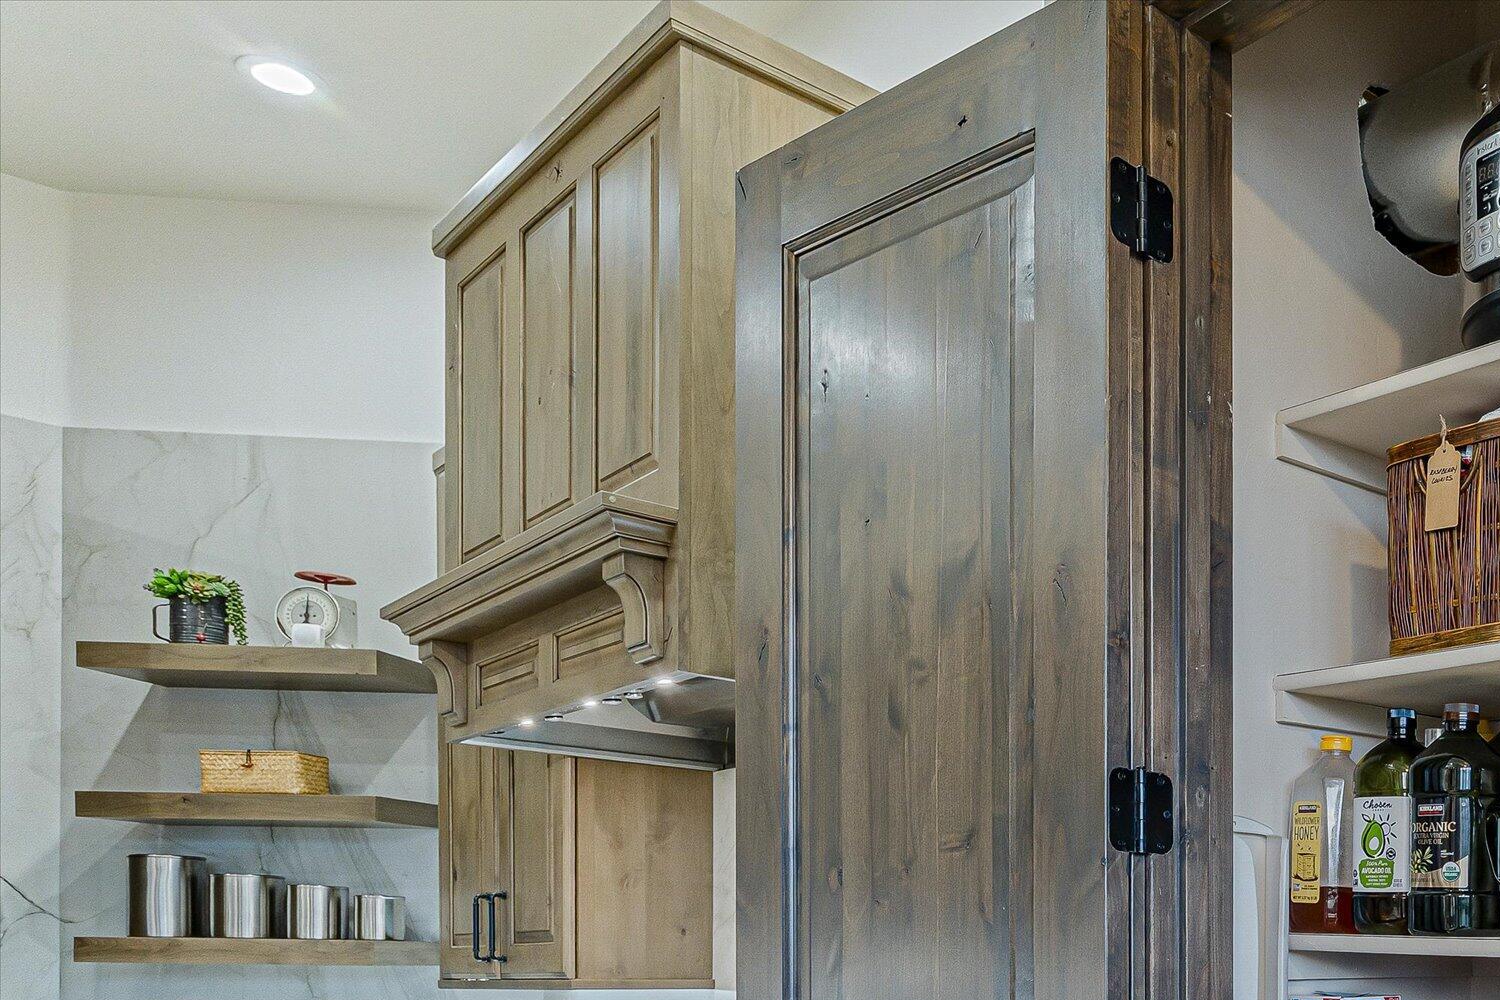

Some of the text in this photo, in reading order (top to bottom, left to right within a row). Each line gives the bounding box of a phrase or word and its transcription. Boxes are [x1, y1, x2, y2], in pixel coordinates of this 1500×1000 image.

[1362, 799, 1393, 810] Chosen
[1293, 825, 1320, 841] HONEY
[1412, 821, 1457, 833] ORGANIC
